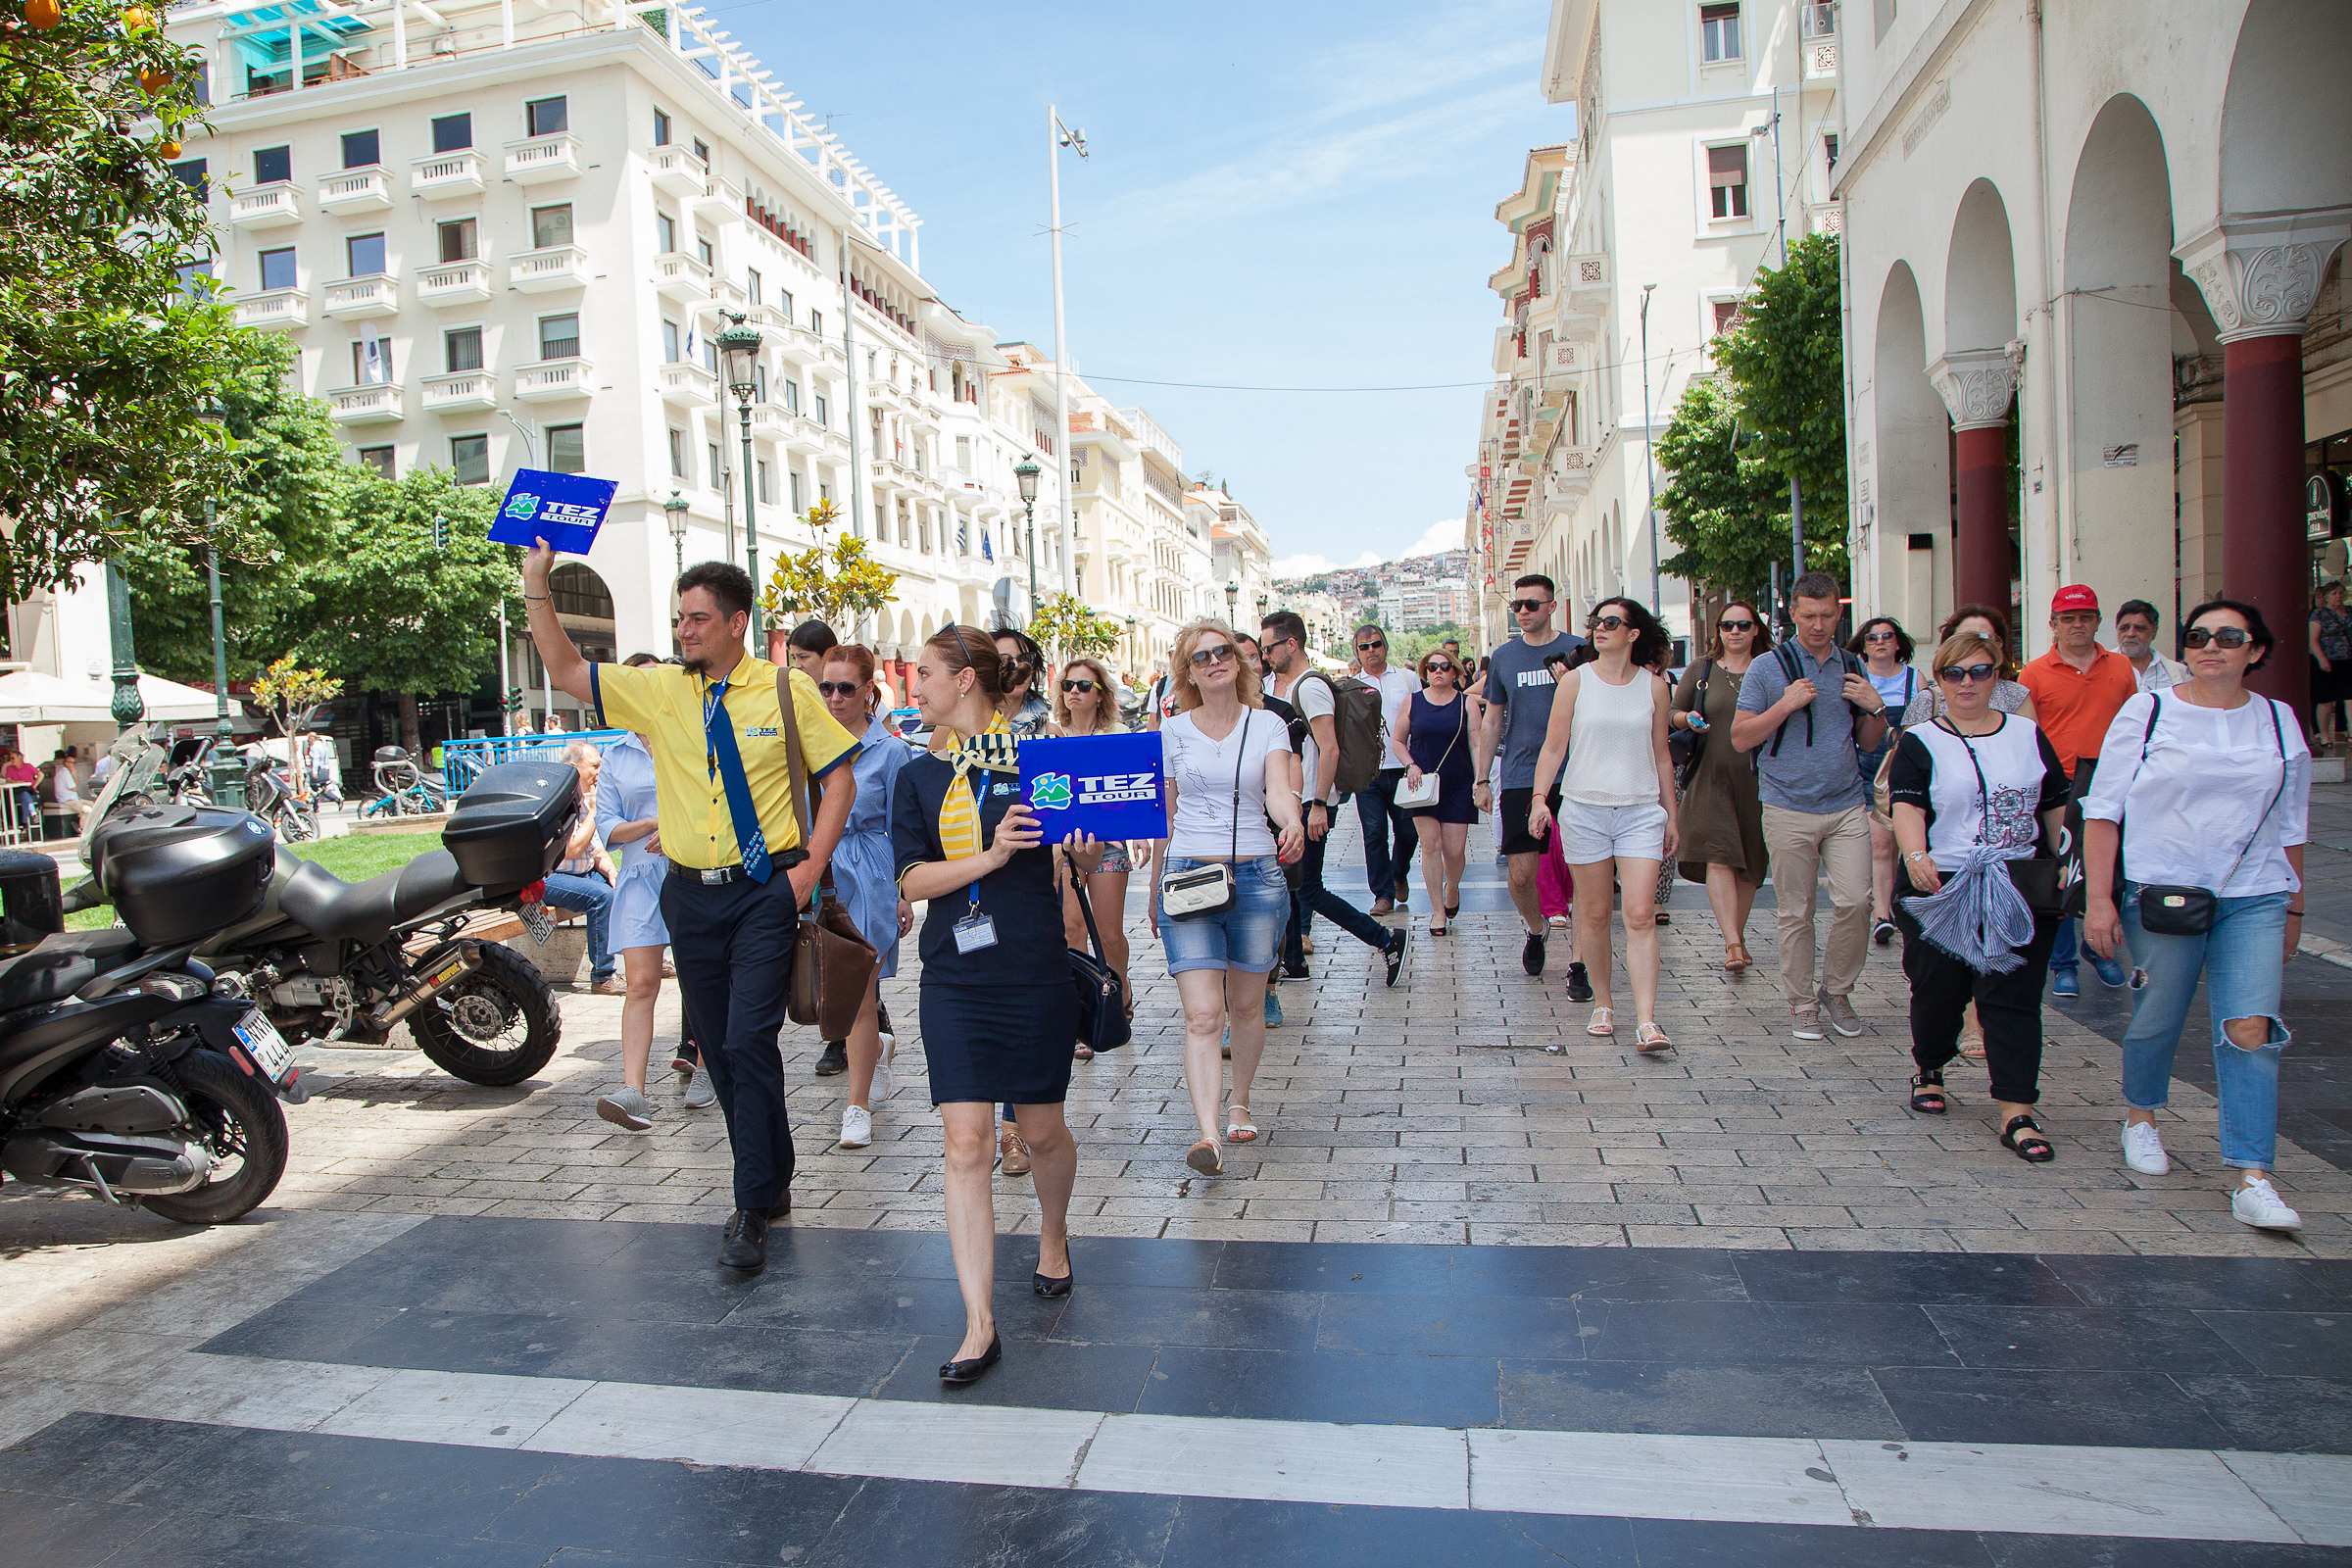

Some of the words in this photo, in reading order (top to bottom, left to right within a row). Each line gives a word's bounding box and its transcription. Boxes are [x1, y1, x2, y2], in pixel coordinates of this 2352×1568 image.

[546, 501, 602, 519] TEZ
[548, 514, 590, 525] TOUR
[1078, 772, 1156, 792] TEZ
[1086, 791, 1149, 802] TOUR
[531, 915, 551, 943] 887
[244, 1012, 273, 1046] NNN
[266, 1038, 293, 1068] 444
